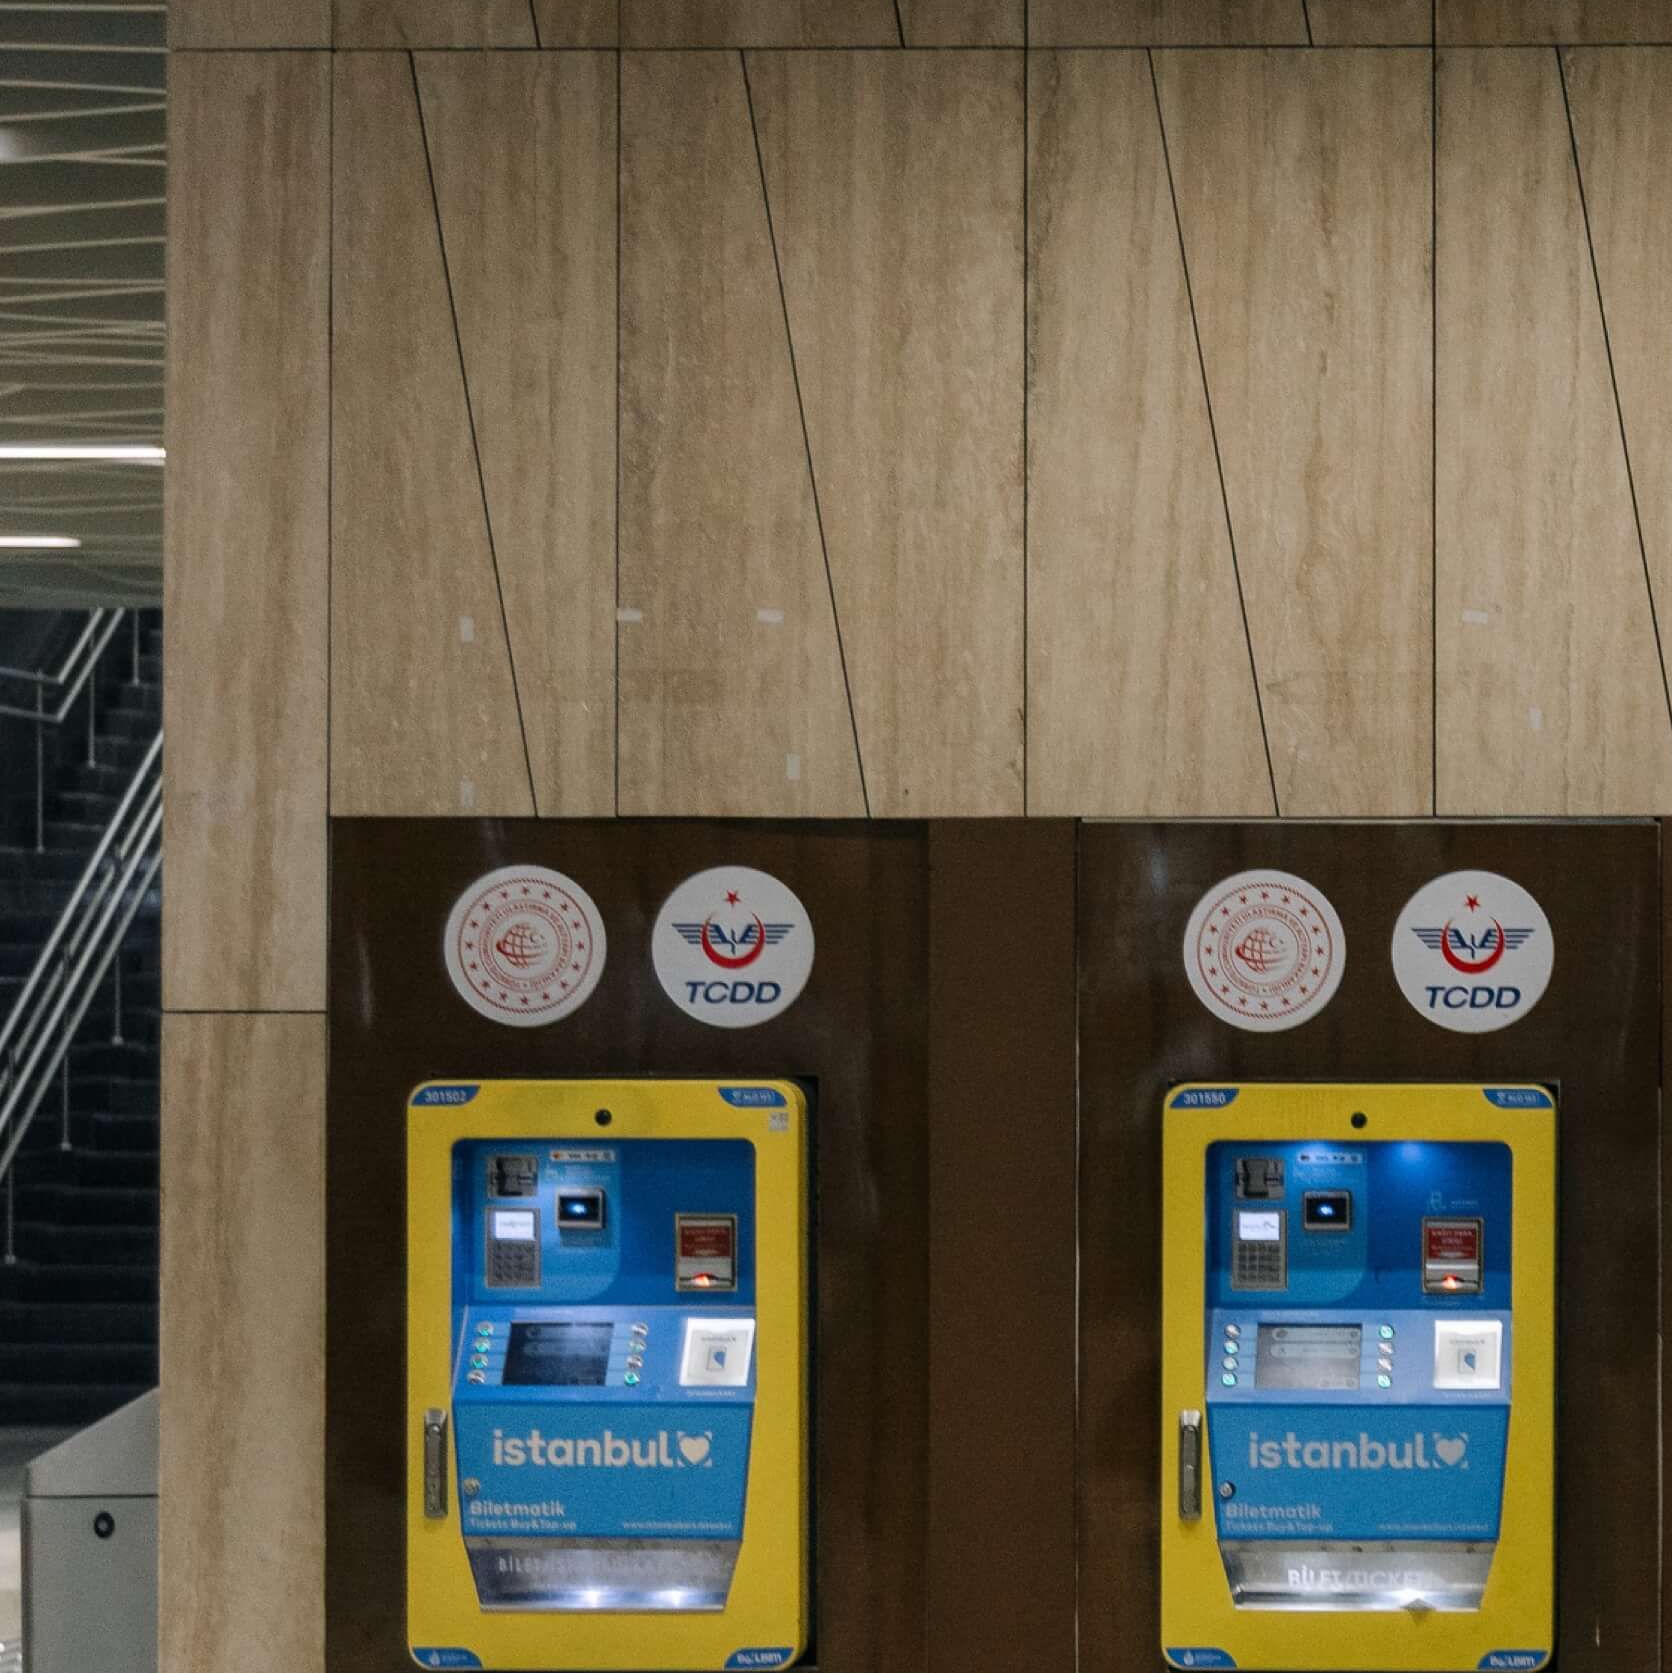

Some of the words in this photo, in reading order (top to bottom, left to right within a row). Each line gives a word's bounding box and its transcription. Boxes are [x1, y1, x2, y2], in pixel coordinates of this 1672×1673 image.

[685, 981, 782, 1004] TCDD
[1425, 985, 1521, 1009] TCDD
[493, 1429, 671, 1468] istanbul
[1249, 1431, 1429, 1469] istanbul
[469, 1500, 565, 1517] Biletmatik
[1225, 1502, 1322, 1520] Biletmatik
